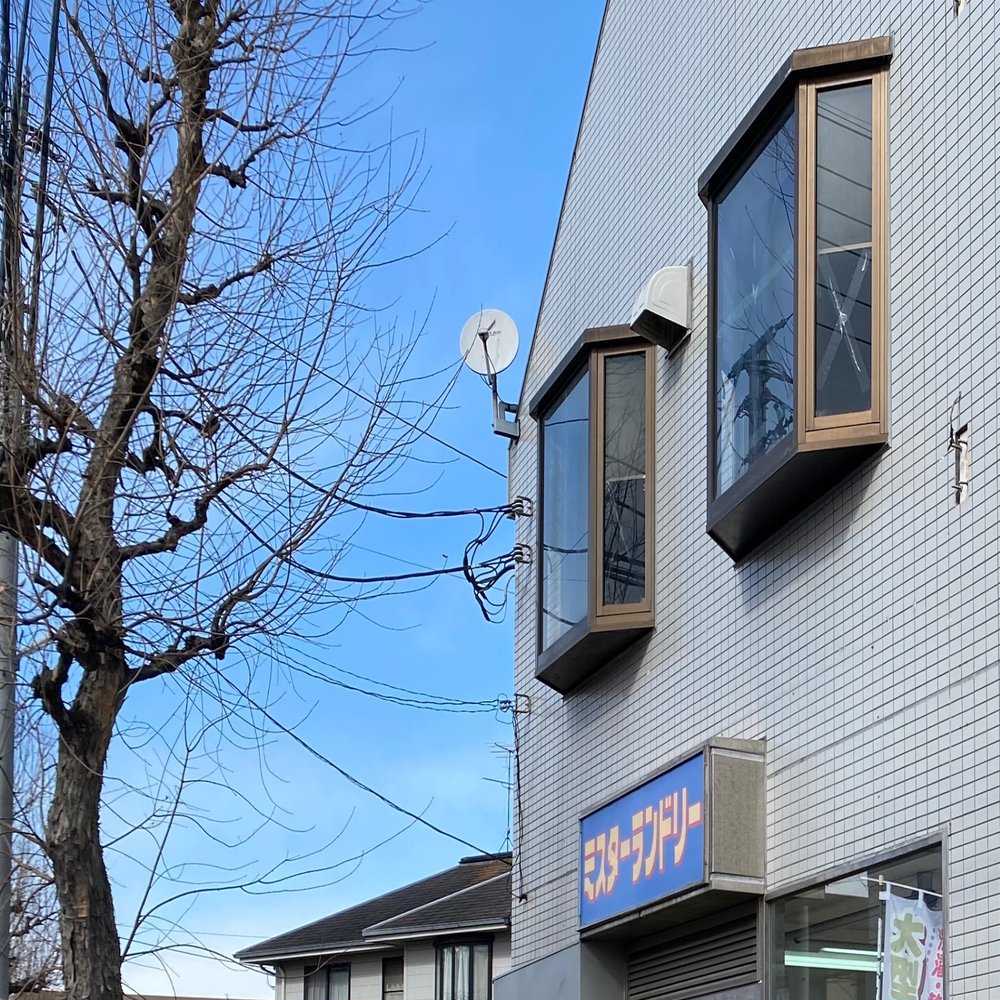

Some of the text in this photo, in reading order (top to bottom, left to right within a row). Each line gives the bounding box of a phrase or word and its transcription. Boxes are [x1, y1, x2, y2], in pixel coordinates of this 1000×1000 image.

[584, 787, 702, 902] ミスターランドリー
